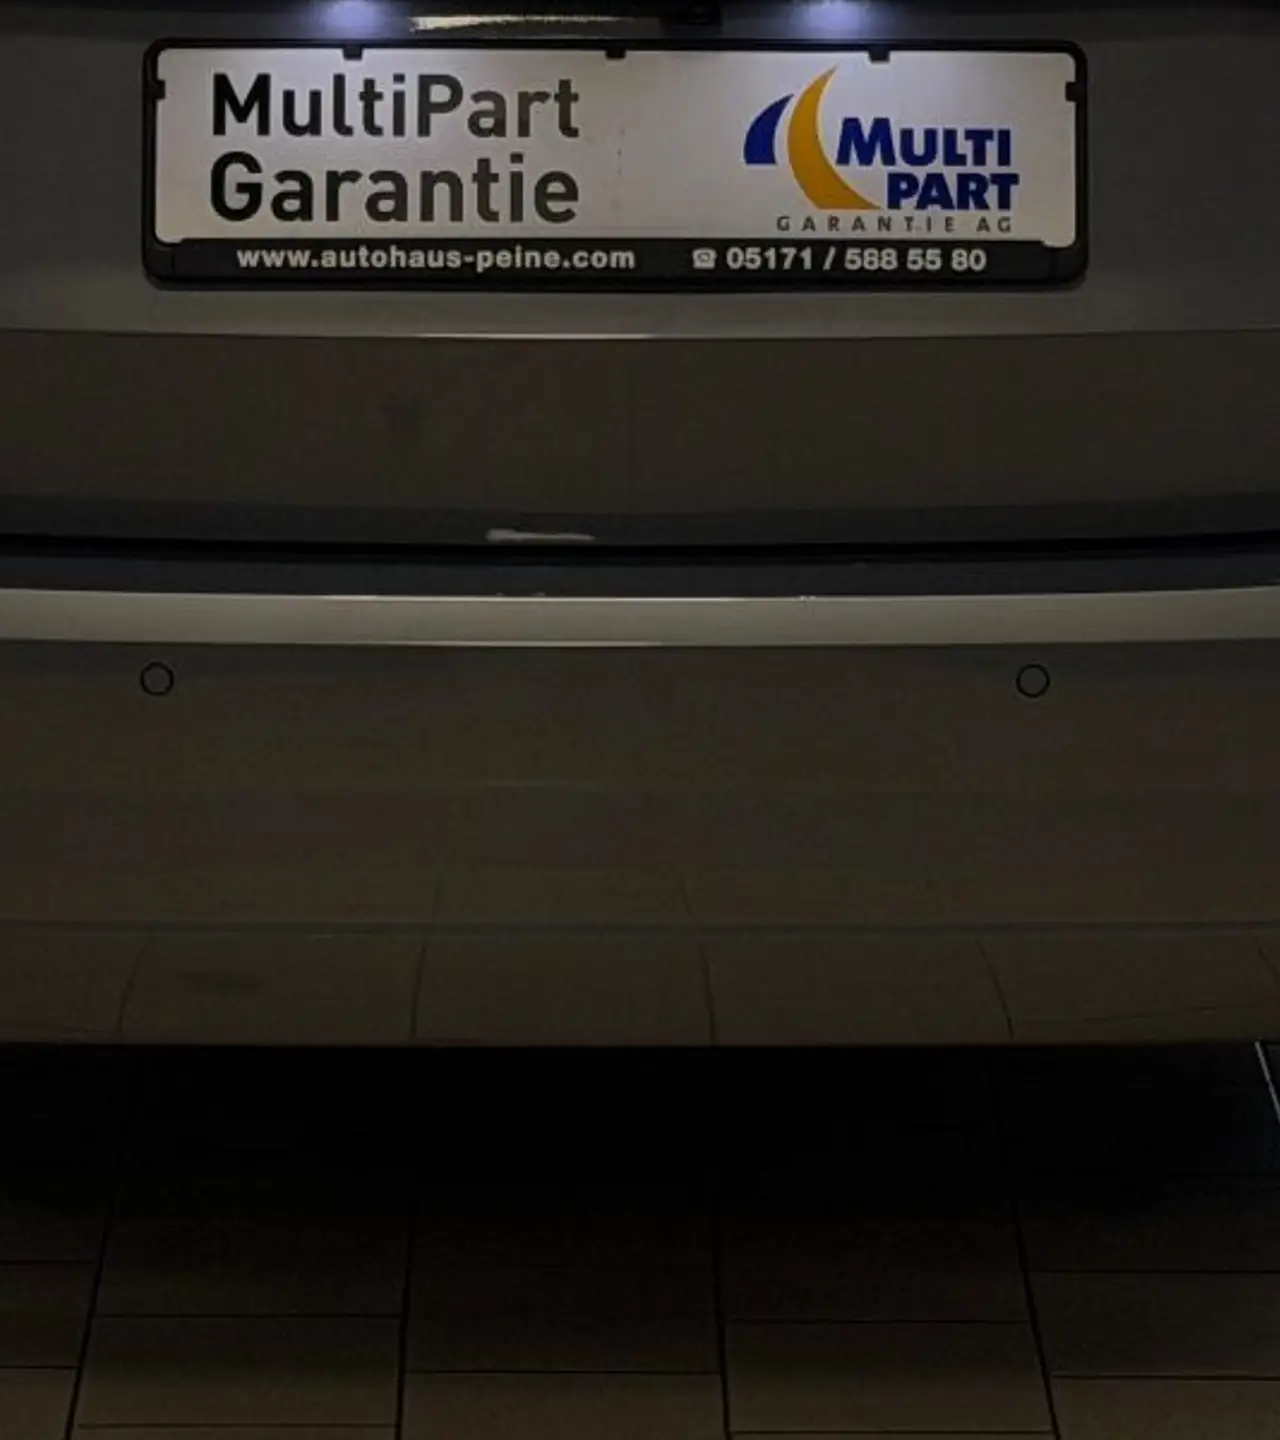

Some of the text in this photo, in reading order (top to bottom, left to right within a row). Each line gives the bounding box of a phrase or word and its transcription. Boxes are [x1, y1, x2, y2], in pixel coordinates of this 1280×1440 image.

[212, 73, 580, 137] MultiPart
[836, 117, 1011, 167] MULTI
[210, 151, 580, 222] Garantie
[887, 173, 1019, 210] PART
[777, 216, 1012, 233] GARANTIE AG
[236, 246, 636, 273] www.autohaus-peine.com
[726, 247, 813, 271] 05171
[823, 247, 836, 271] /
[907, 249, 942, 272] 55
[951, 249, 987, 271] 80
